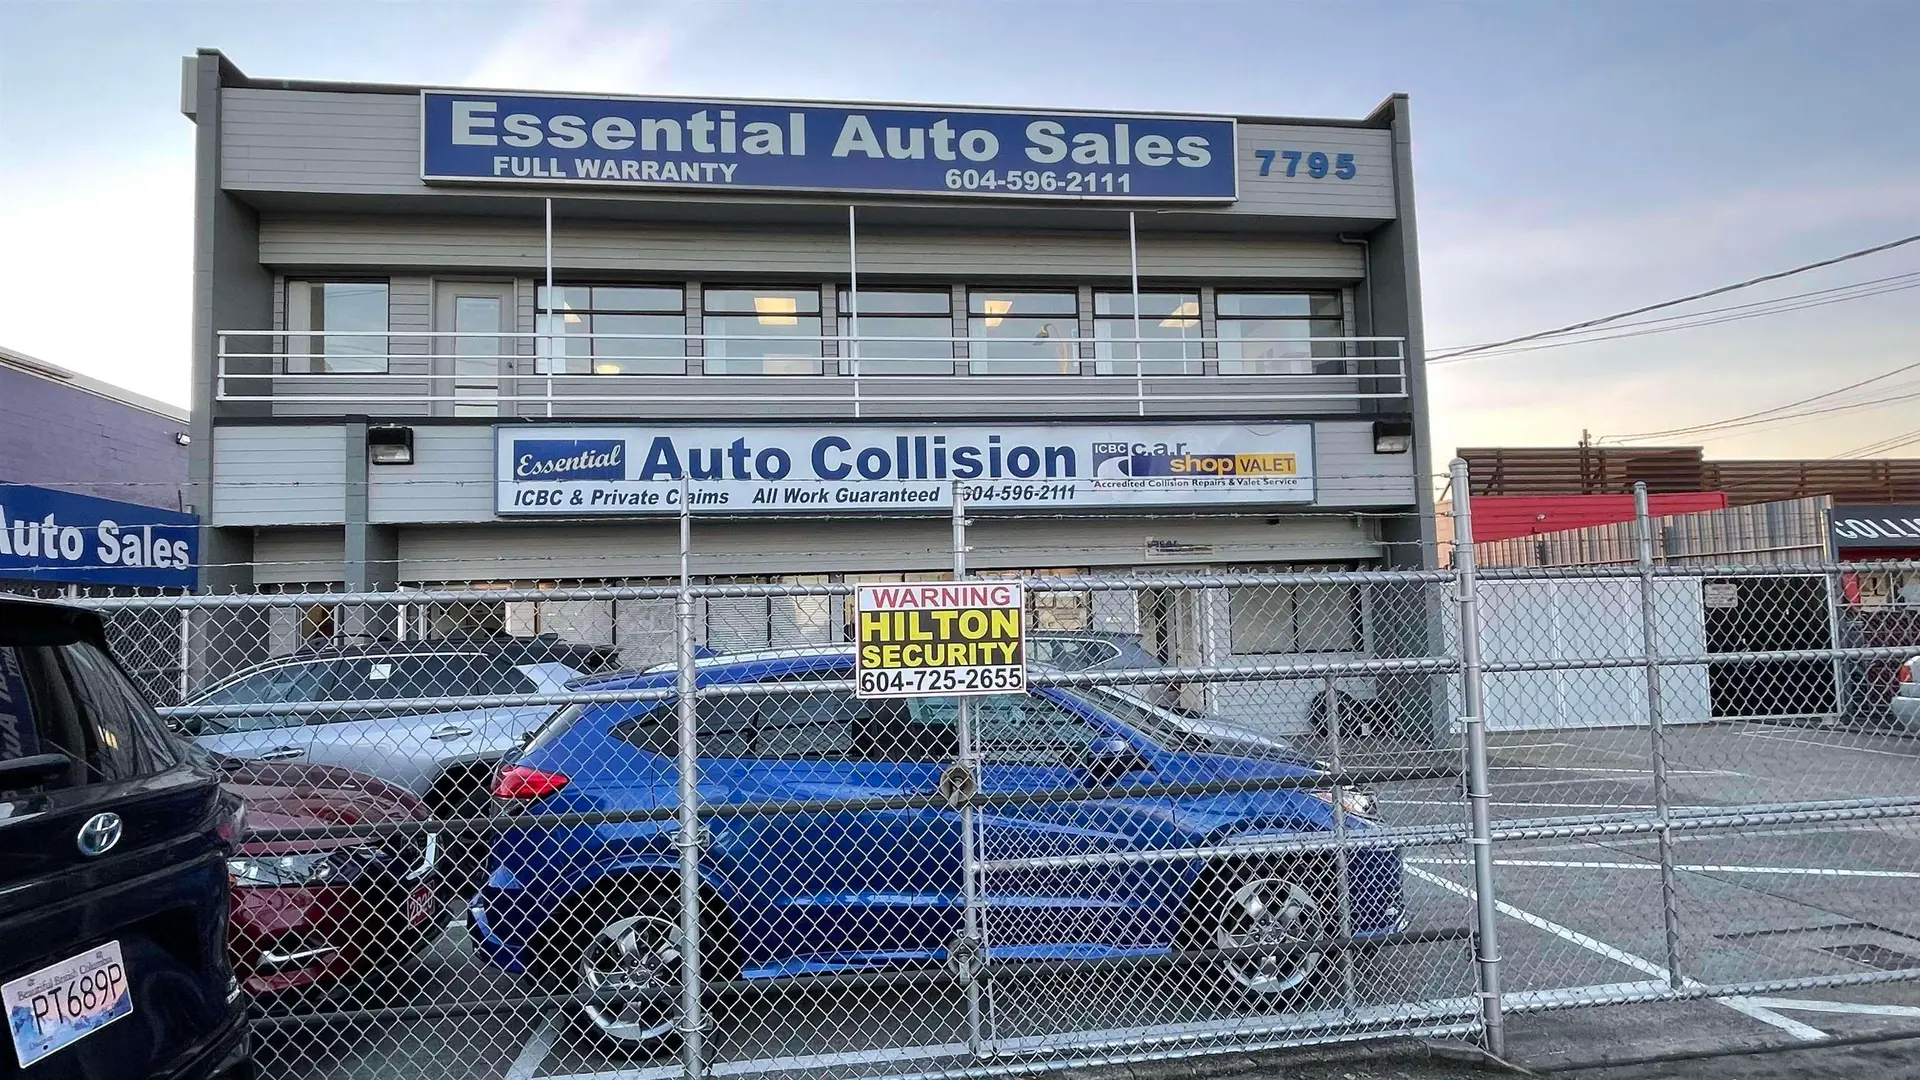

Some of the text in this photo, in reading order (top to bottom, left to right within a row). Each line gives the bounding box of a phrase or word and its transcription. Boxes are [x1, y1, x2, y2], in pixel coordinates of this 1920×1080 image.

[452, 100, 1212, 167] Essential Auto Sales
[493, 156, 738, 183] FULL WARRANTY
[1255, 150, 1356, 180] 7795
[945, 168, 1131, 193] 604-596-2111
[517, 444, 621, 477] Essential
[639, 435, 1077, 480] Auto Collision
[1095, 444, 1126, 454] ICBC
[1170, 454, 1294, 475] shop VALET
[752, 486, 941, 504] All Work Guaranteed
[1094, 480, 1145, 488] Accredited
[1148, 479, 1189, 488] Collision
[1192, 479, 1226, 488] Repairs
[1263, 477, 1298, 486] Service
[514, 488, 729, 506] ICBC & Private Caims
[97, 519, 190, 570] Sales
[872, 586, 1011, 608] WARNING
[862, 609, 1019, 642] HILTON
[862, 641, 1019, 668] SECURITY
[862, 667, 1022, 692] 604-725-2655
[32, 963, 122, 1035] PT689P
